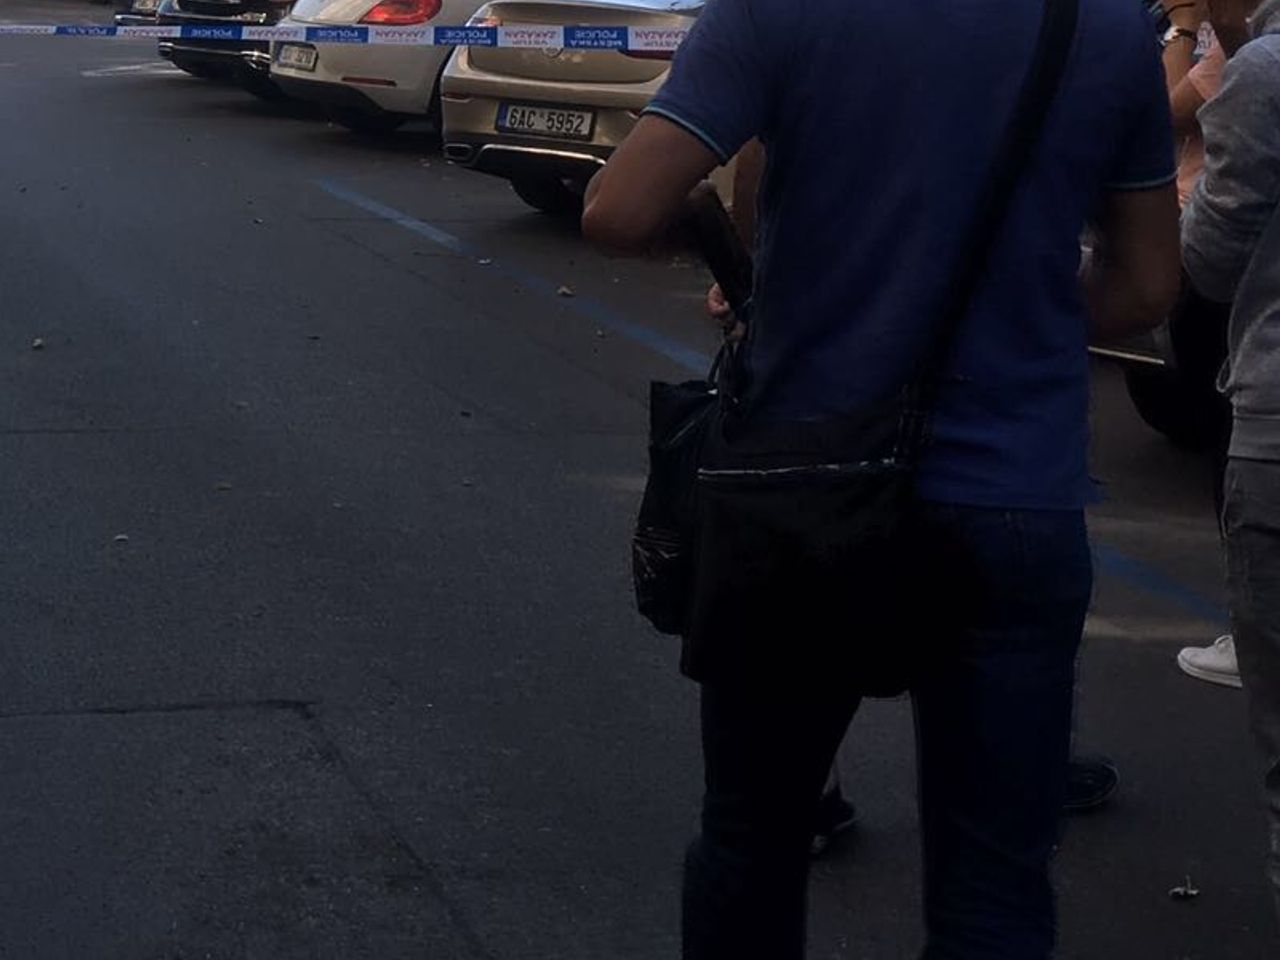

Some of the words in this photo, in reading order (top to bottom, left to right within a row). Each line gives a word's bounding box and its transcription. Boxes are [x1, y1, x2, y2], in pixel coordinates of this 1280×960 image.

[444, 29, 488, 39] POLICIE
[574, 29, 618, 40] POLICIE
[509, 107, 536, 129] 6AC
[546, 111, 585, 133] 5952
